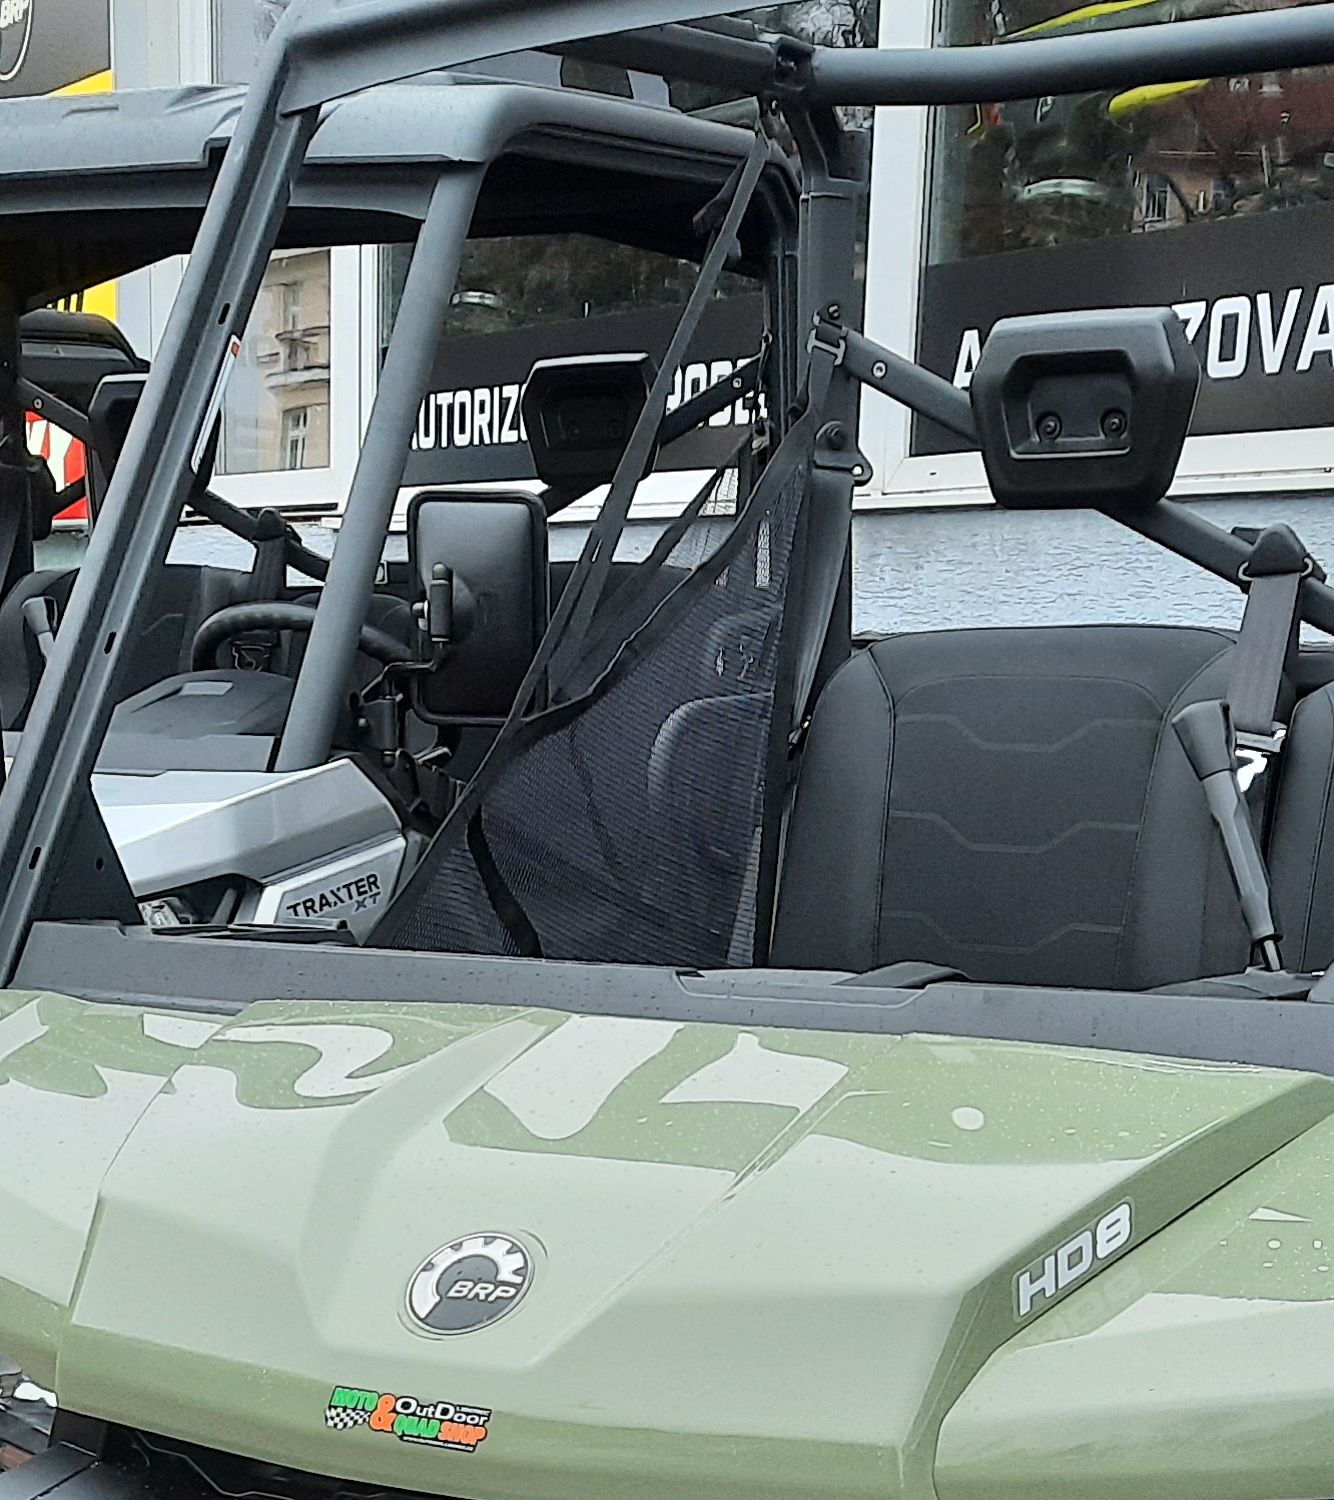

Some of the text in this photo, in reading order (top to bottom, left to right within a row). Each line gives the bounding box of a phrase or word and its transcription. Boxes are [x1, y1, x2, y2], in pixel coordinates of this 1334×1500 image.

[286, 873, 380, 917] TRAXTER
[354, 891, 381, 913] XT
[1018, 1203, 1131, 1317] HD8
[446, 1280, 518, 1303] BRP
[331, 1386, 379, 1412] MOTO
[395, 1396, 489, 1426] OutDoor
[394, 1414, 441, 1438] QUAD
[438, 1421, 487, 1446] SHOP
